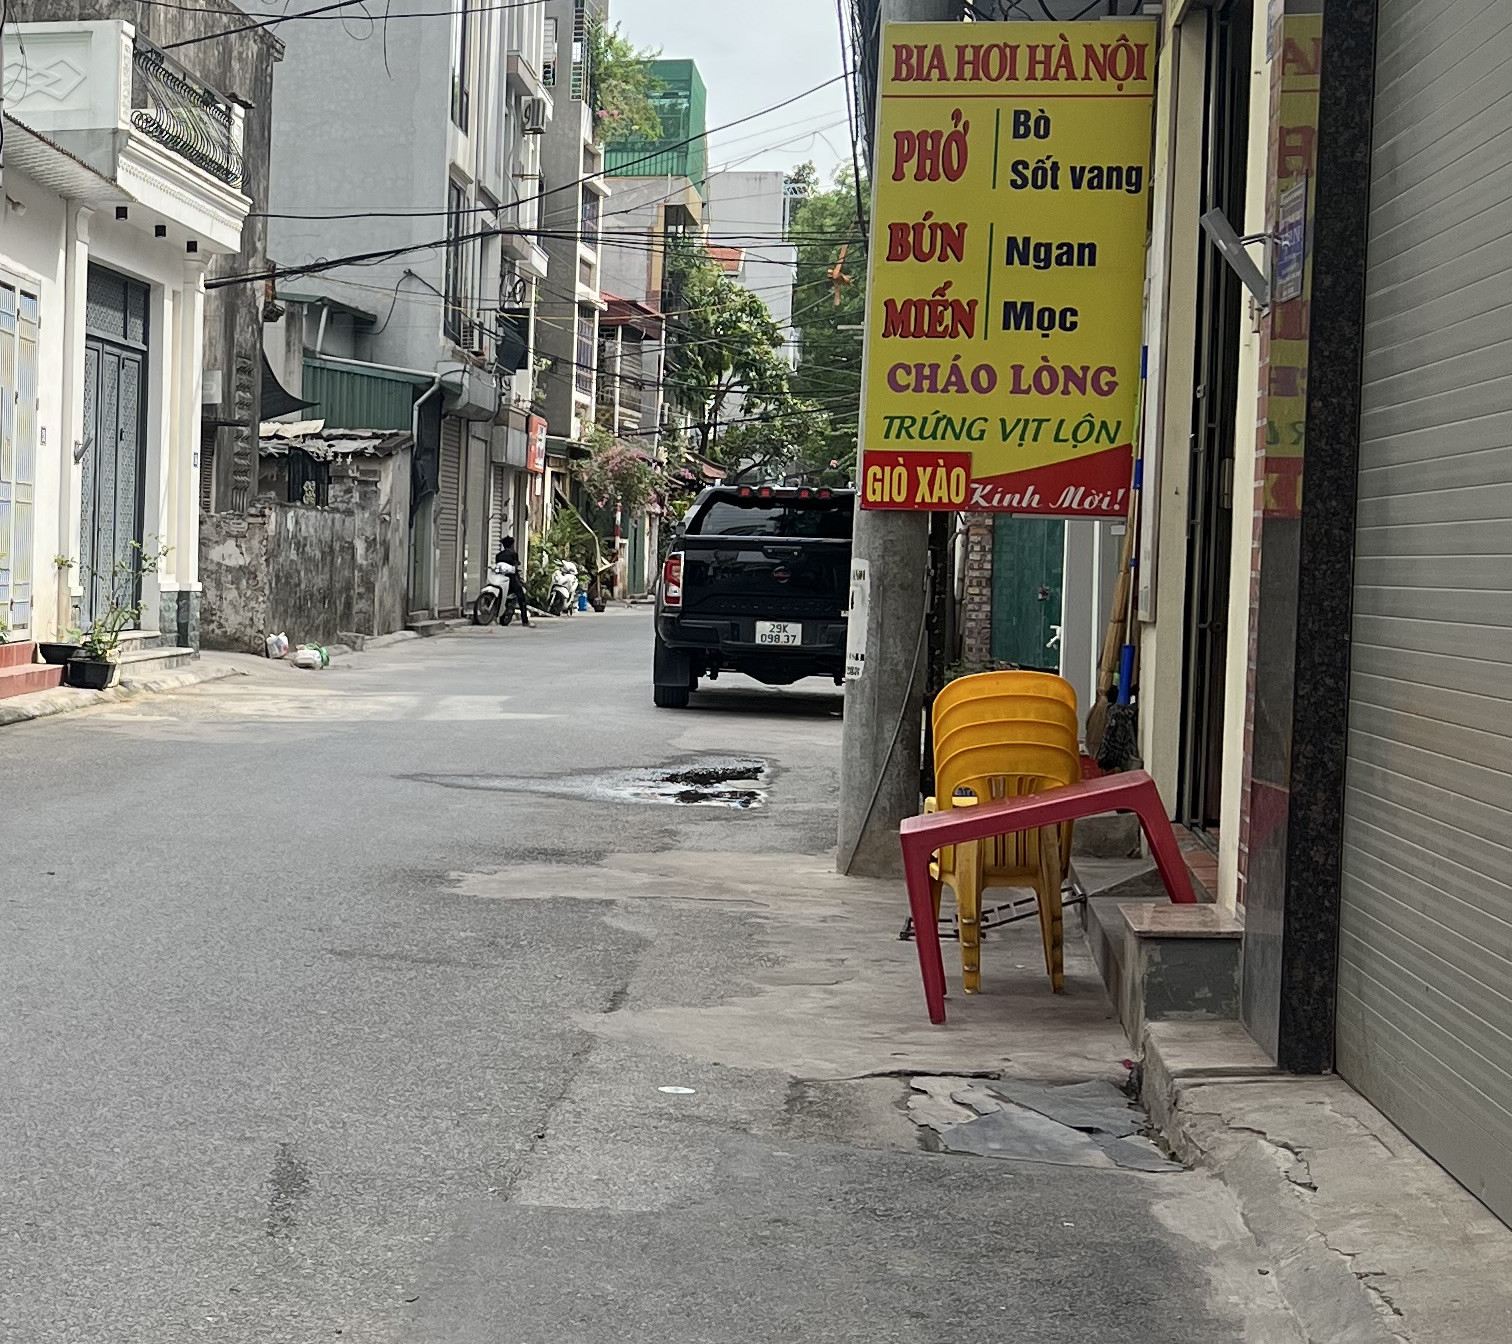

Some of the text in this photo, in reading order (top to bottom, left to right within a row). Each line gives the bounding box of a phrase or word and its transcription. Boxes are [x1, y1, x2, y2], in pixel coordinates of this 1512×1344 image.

[891, 32, 1149, 91] BIA HƠI HÀ NỘI
[1012, 108, 1051, 140] Bò
[891, 107, 970, 182] PHỞ
[1009, 154, 1144, 194] Sốt vang
[885, 210, 968, 263] BÚN
[1005, 236, 1097, 270] Ngan
[881, 280, 978, 339] MIẾN
[1001, 300, 1079, 338] Mọc
[887, 354, 1119, 397] CHÁO LÒNG
[882, 410, 1122, 448] TRỨNG VỊT LỘN
[866, 457, 966, 504] GIÒ XÀO
[970, 483, 1126, 511] Kính Mời!
[760, 634, 797, 644] 098.37
[768, 623, 789, 634] 29K
